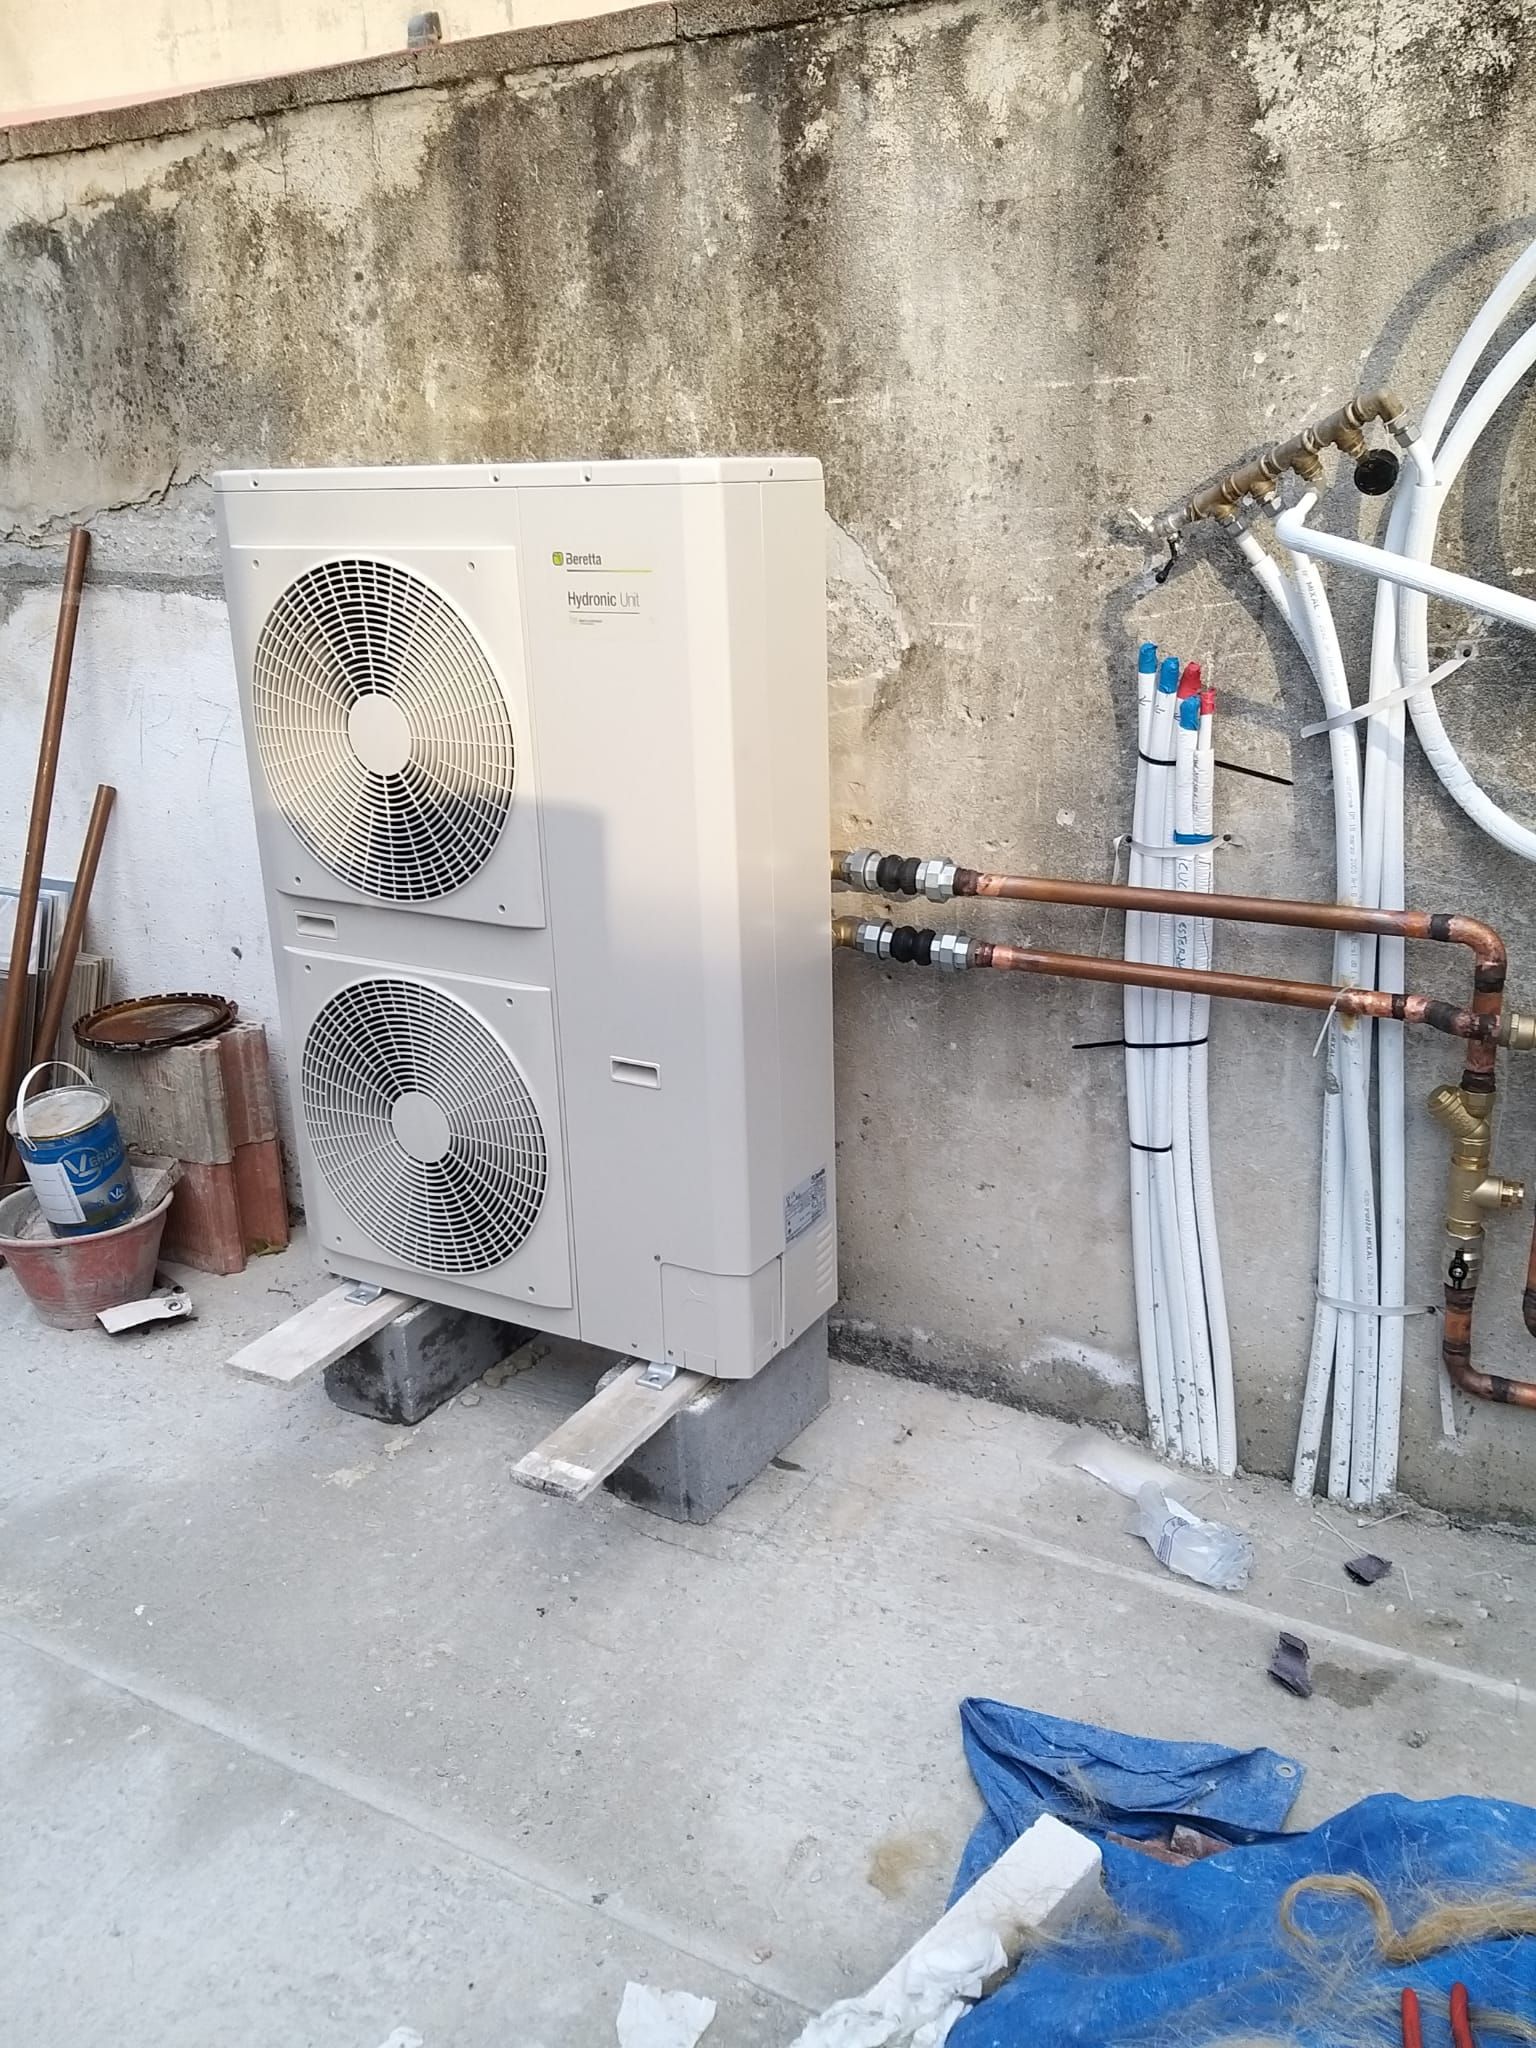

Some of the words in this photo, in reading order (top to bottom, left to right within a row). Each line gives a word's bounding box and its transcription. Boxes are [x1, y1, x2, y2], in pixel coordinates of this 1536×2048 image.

[565, 552, 602, 566] Beretta
[567, 590, 617, 609] Hydronic
[619, 591, 640, 608] Unit
[1307, 581, 1319, 611] MIXAL
[1176, 922, 1188, 968] ESTERN
[1365, 1236, 1374, 1261] MIXAL
